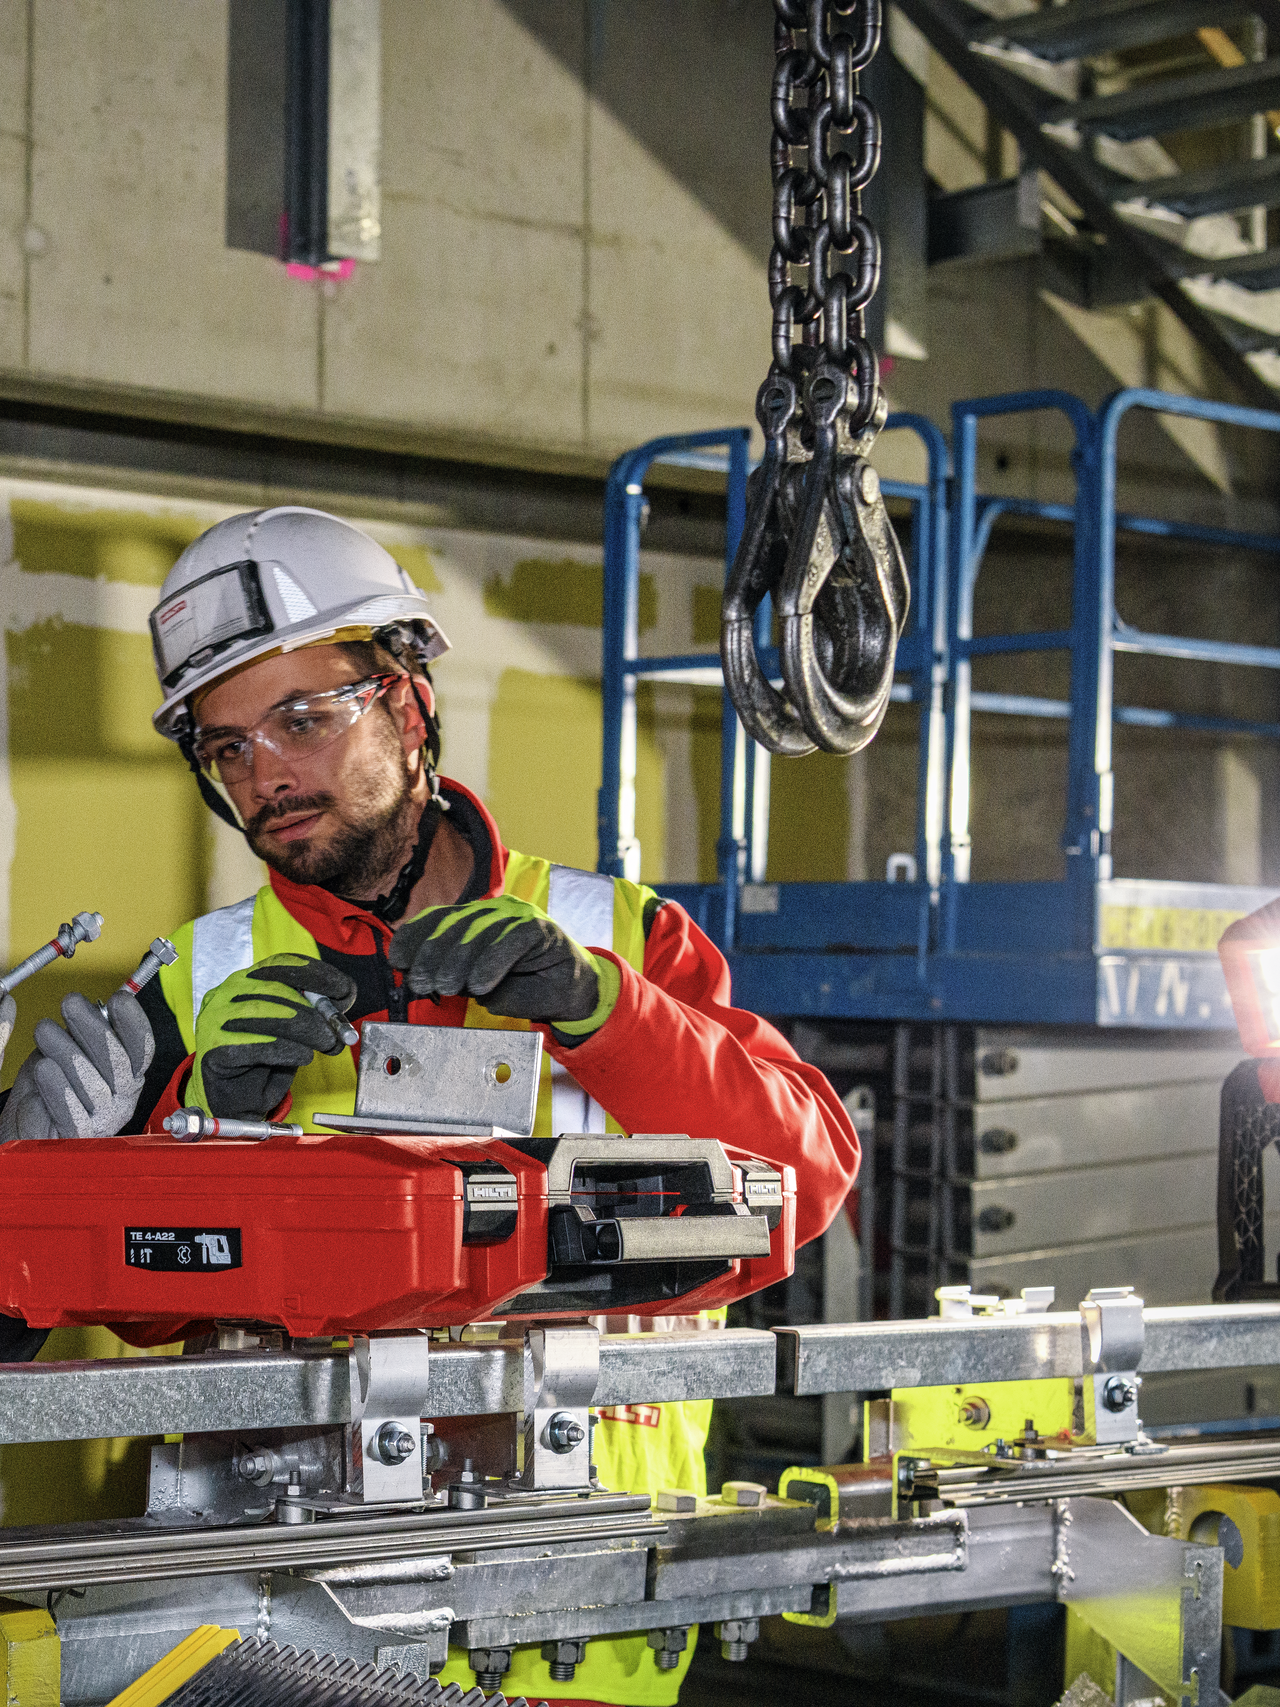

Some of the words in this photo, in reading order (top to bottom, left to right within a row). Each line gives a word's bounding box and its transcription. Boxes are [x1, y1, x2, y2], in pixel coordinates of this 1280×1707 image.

[472, 1187, 512, 1198] HILTI
[749, 1184, 778, 1195] HILTI
[130, 1232, 143, 1241] TE
[145, 1232, 176, 1241] 4-A22
